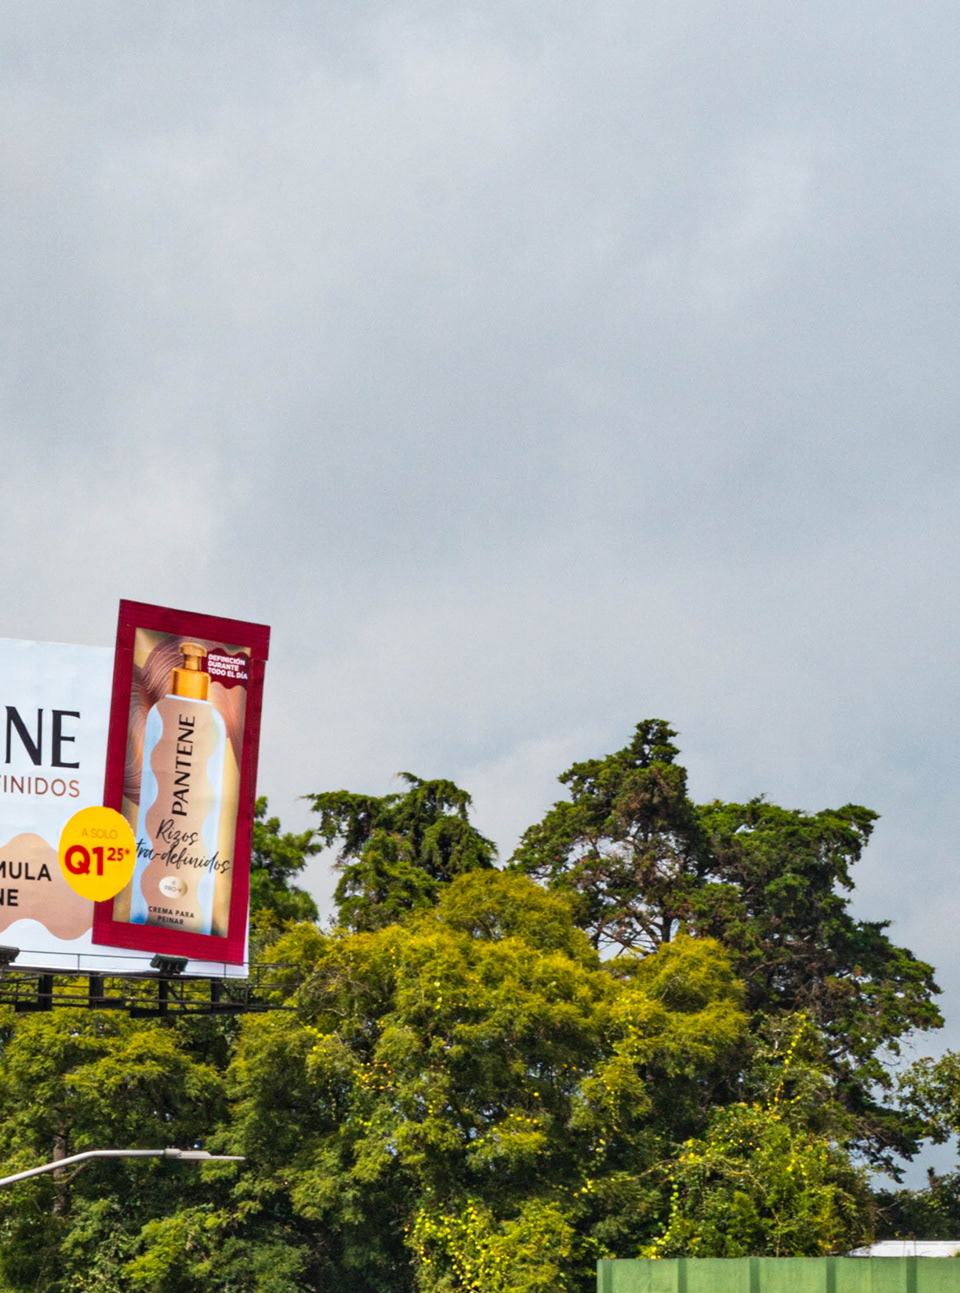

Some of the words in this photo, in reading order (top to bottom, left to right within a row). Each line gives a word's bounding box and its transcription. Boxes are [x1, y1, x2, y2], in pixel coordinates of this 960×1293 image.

[208, 660, 239, 672] DURANTE
[208, 666, 227, 677] TODO
[227, 670, 236, 679] EL
[171, 713, 196, 817] PANTENE
[81, 829, 89, 839] A
[91, 829, 118, 840] SOLO
[155, 819, 199, 846] Rizos
[148, 905, 173, 915] CREMA
[175, 910, 195, 918] PARA
[157, 915, 184, 925] PEINAR
